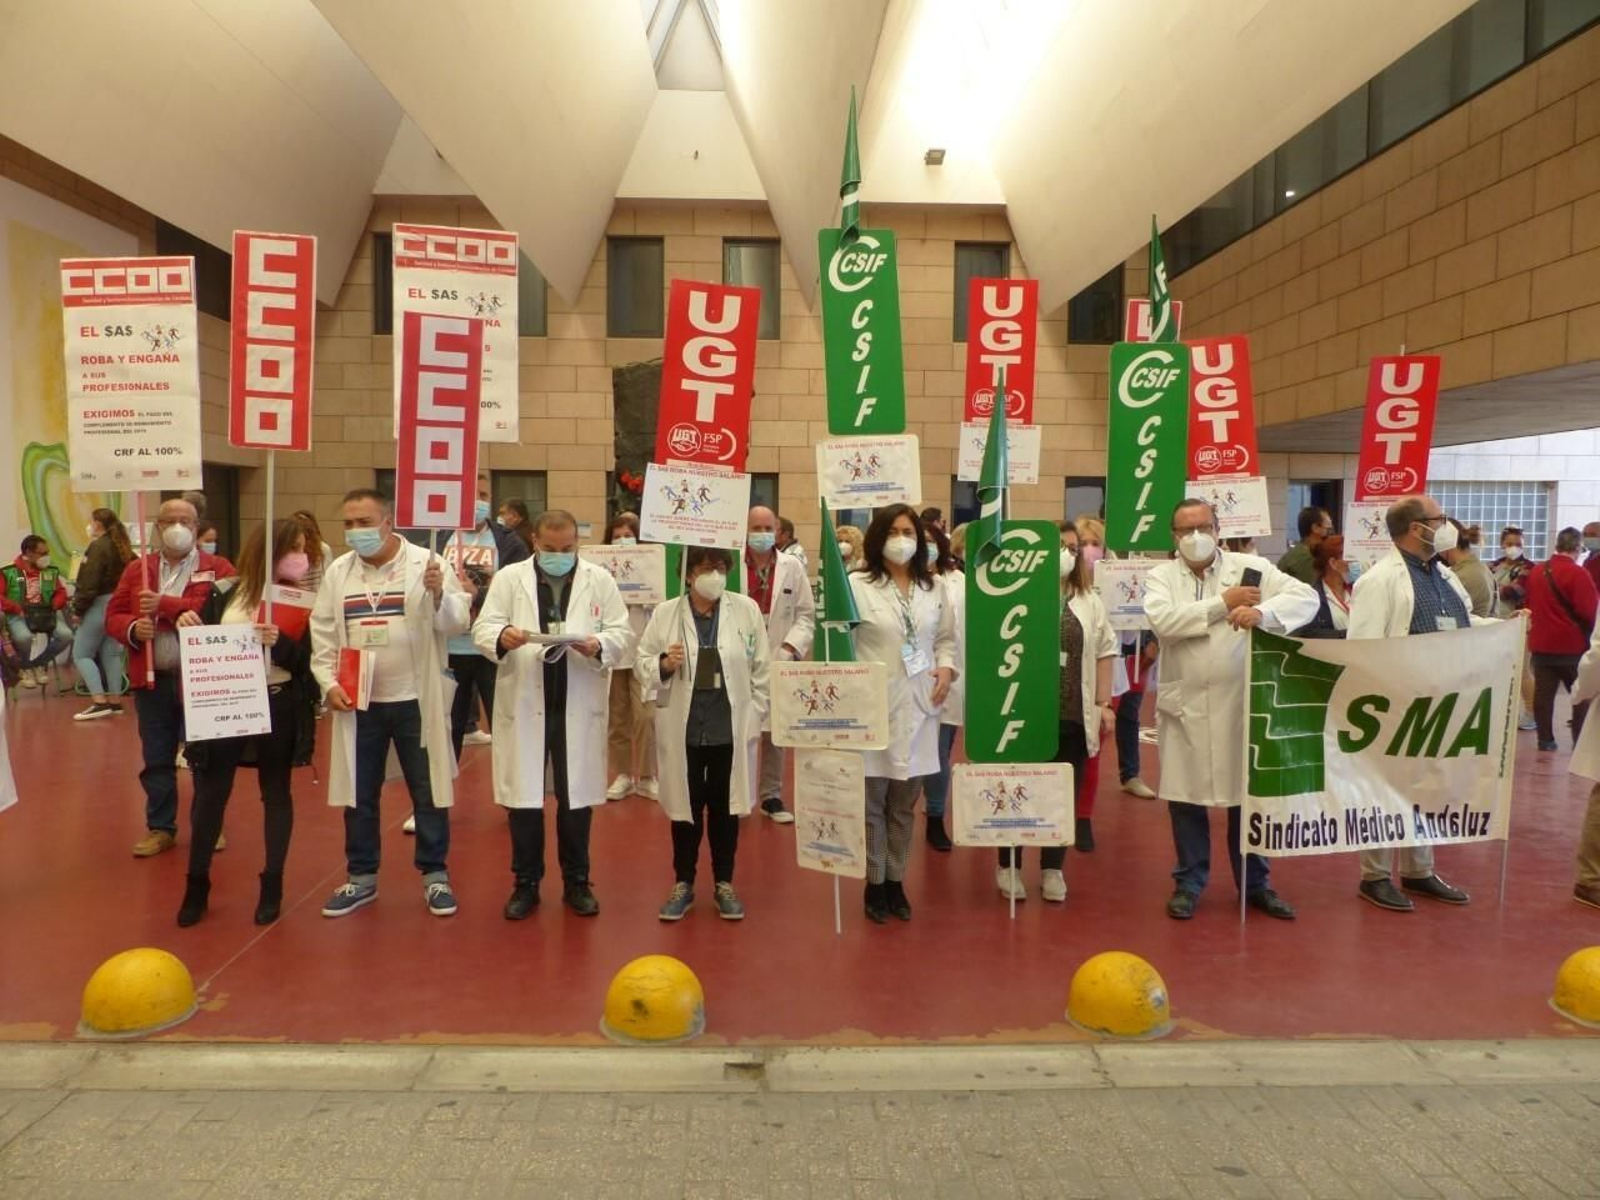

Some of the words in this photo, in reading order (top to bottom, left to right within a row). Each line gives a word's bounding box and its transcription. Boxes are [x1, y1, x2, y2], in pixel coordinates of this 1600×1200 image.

[396, 232, 516, 266] CCOO
[840, 252, 888, 273] CSIF
[62, 266, 191, 296] CCOO
[408, 288, 426, 299] EL
[431, 289, 458, 300] SAS
[80, 326, 99, 337] EL
[104, 325, 133, 337] SAS
[244, 237, 298, 447] CCOO
[980, 285, 1024, 388] UGT
[81, 356, 114, 365] ROBA
[118, 355, 126, 363] Y
[680, 290, 743, 423] UGT
[852, 299, 878, 427] CSIF
[82, 382, 170, 392] PROFESIONALES
[1131, 367, 1181, 388] CSIF
[1190, 343, 1240, 443] UGT
[83, 410, 135, 419] EXIGIMOS
[480, 401, 501, 409] 00%
[1375, 363, 1424, 465] UGT
[413, 316, 471, 528] CCOO
[703, 432, 722, 444] FSP
[114, 448, 137, 456] CRF
[138, 447, 151, 455] AL
[155, 447, 183, 456] 100%
[1130, 416, 1162, 543] CSIF
[991, 549, 1049, 573] CSIF
[187, 637, 202, 646] EL
[205, 636, 227, 645] SAS
[189, 656, 214, 665] ROBA
[190, 673, 255, 683] PROFESIONALES
[996, 604, 1028, 753] CSIF
[190, 688, 231, 698] EXIGIMOS
[1337, 687, 1492, 758] SMA
[1248, 812, 1338, 851] Sindicato
[1345, 805, 1405, 847] Médico
[1412, 803, 1491, 841] Andaluz
